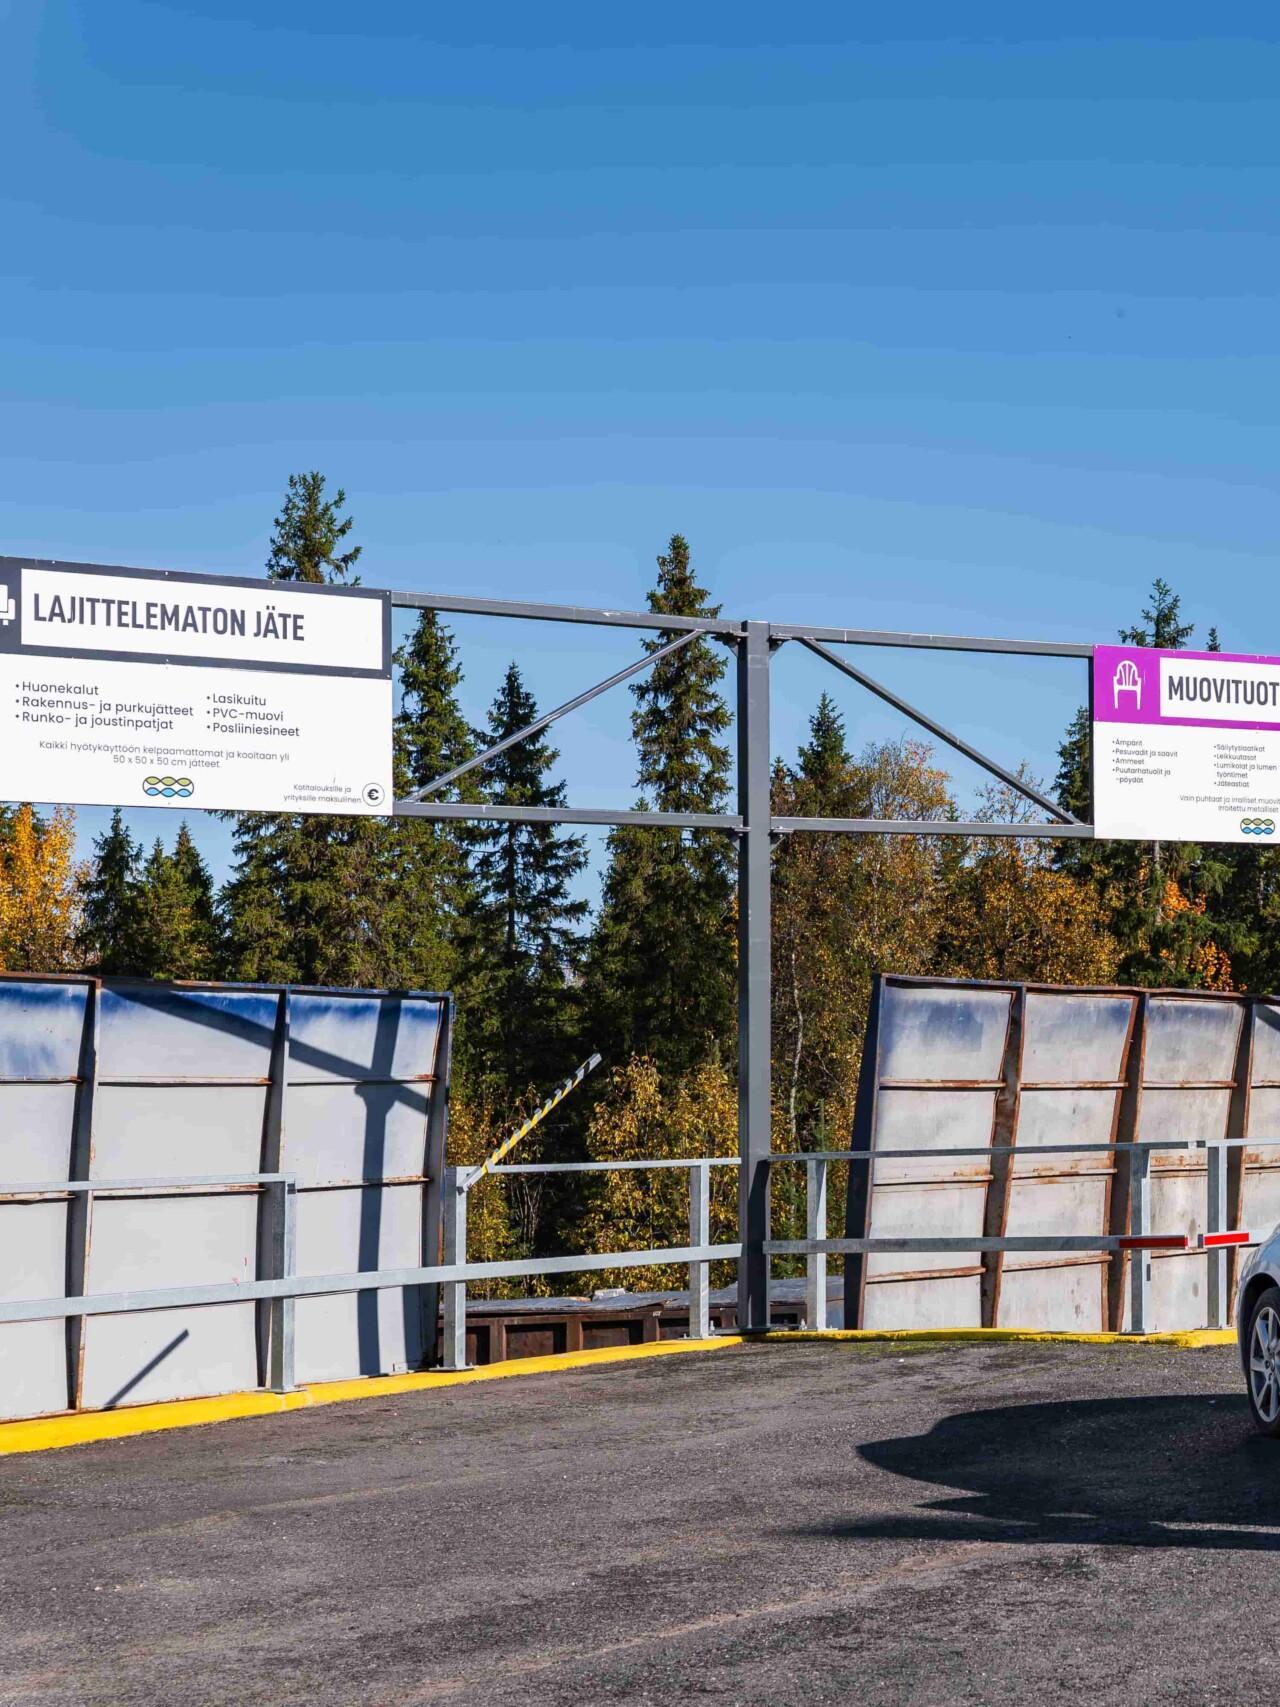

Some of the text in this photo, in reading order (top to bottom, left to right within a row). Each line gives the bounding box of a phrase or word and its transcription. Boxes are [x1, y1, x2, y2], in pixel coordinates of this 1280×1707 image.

[33, 592, 305, 641] LAJITTELEMATON JÄTE
[22, 681, 99, 695] Huonekalut
[213, 693, 266, 706] Lasikuitu
[22, 697, 194, 717] Rakennus- ja purkujätteet
[213, 708, 283, 721] PVC-muovi
[22, 712, 173, 732] Runko- ja joustinpatjat
[213, 722, 300, 736] Posliiniesineet
[1115, 738, 1142, 748] Ämpärit
[40, 741, 289, 762] Kaikki hyötykäyttöön kelpaamattomat ja kooltaan yli
[1115, 748, 1178, 758] Pesuvadit ja saavit
[114, 755, 125, 763] 50
[135, 756, 147, 764] 50
[157, 757, 169, 765] 50
[1115, 757, 1144, 765] Ammeet
[1115, 766, 1171, 776] Puutarhatuolit ja
[1249, 763, 1256, 772] ja
[294, 784, 351, 794] Kotitalouksille ja
[284, 794, 316, 802] yrityksille
[1180, 794, 1195, 802] Vain
[1196, 796, 1223, 804] puhtaat
[1224, 796, 1230, 804] ja
